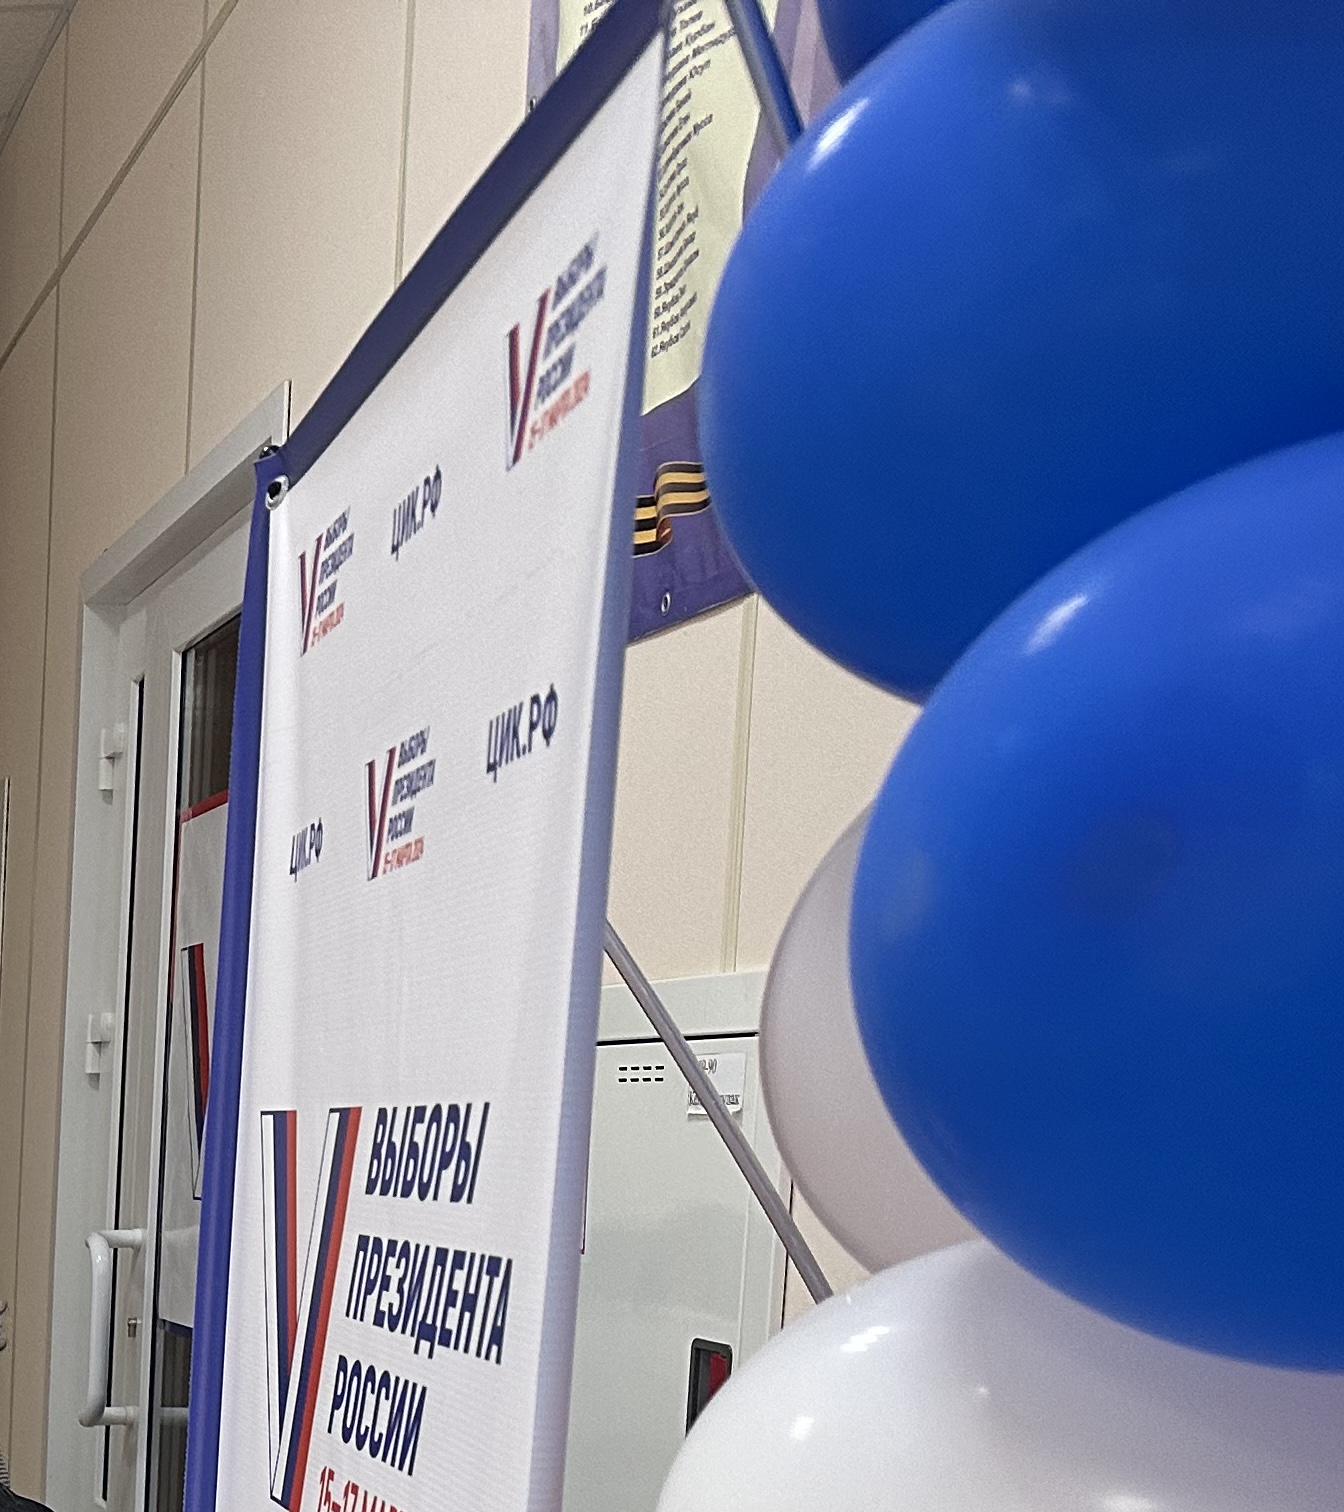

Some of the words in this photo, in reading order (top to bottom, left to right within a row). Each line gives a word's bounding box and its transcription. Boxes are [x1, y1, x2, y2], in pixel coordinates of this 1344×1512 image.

[486, 683, 559, 783] ЦИК.РФ
[364, 1102, 490, 1204] ВЫБОРЫ
[345, 1233, 513, 1364] ПРЕЗИДЕНТА
[327, 1354, 428, 1476] РОССИИ
